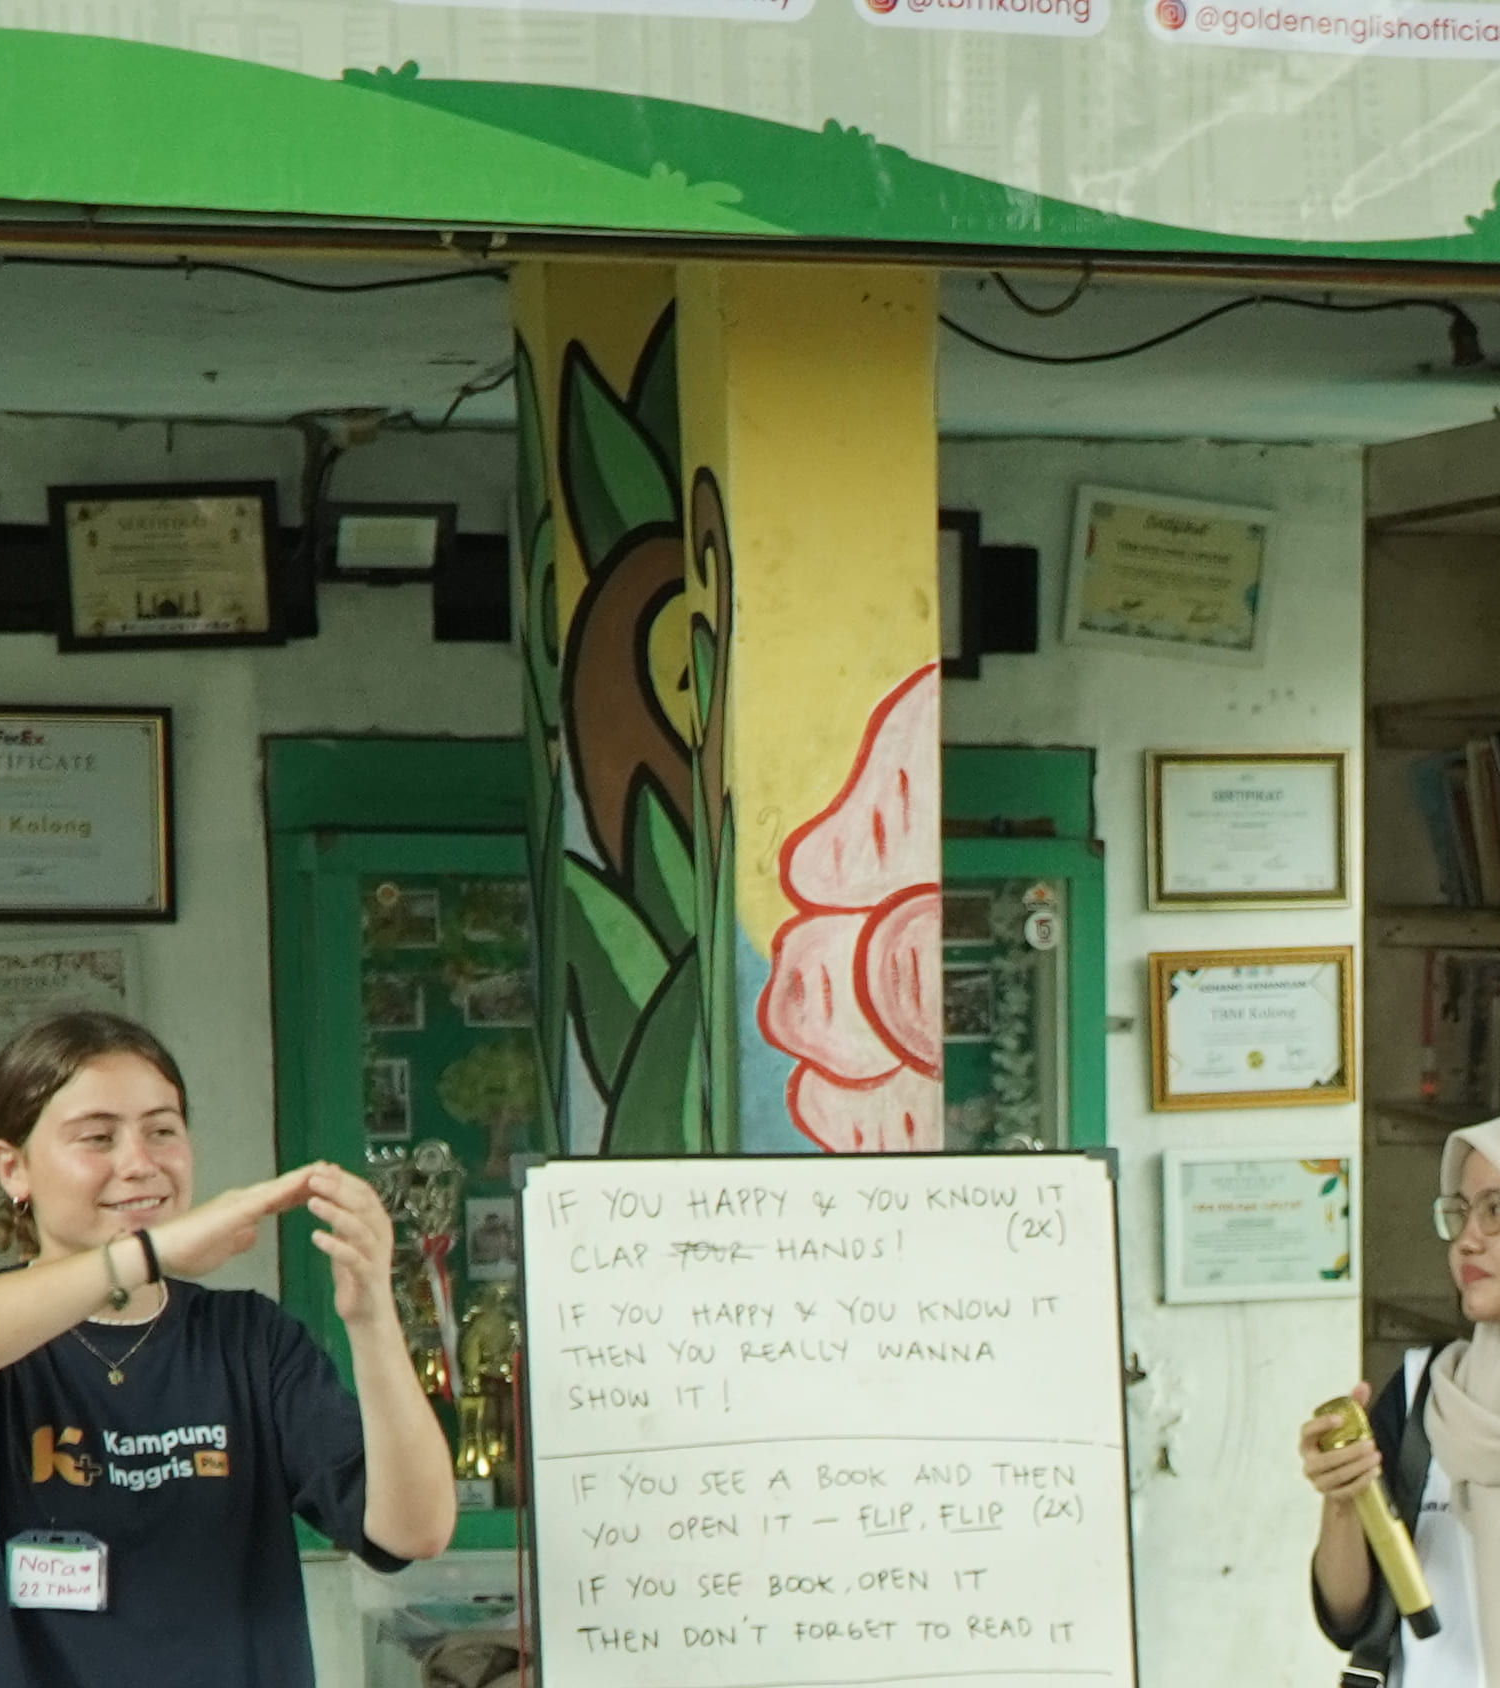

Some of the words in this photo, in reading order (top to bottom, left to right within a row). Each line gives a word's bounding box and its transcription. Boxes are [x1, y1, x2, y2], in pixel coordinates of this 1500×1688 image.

[10, 814, 92, 837] Kolong
[548, 1190, 580, 1228] IF
[600, 1188, 662, 1220] YOU
[686, 1187, 789, 1219] HAPPY
[857, 1187, 909, 1213] YOU
[926, 1185, 1019, 1210] KNOW
[1037, 1184, 1066, 1203] IT
[570, 1242, 648, 1274] CLAP
[775, 1229, 906, 1263] HANDS!
[558, 1301, 586, 1333] IF
[610, 1301, 664, 1328] YOU
[691, 1300, 775, 1329] HAPPY
[839, 1297, 898, 1325] YOU
[917, 1294, 1013, 1323] KNOW
[1031, 1294, 1060, 1317] IT
[560, 1344, 648, 1368] THEN
[667, 1341, 717, 1365] YOU
[739, 1337, 850, 1364] REALLY
[876, 1340, 997, 1363] WANNA
[567, 1384, 651, 1411] SHOW
[103, 1424, 228, 1456] Kampung
[108, 1456, 194, 1491] Inggris
[572, 1471, 597, 1507] IF
[619, 1465, 678, 1501] YOU
[699, 1469, 746, 1496] SEE
[767, 1466, 793, 1492] A
[816, 1464, 888, 1490] BOOK
[914, 1463, 973, 1488] AND
[991, 1462, 1077, 1490] THEN
[581, 1521, 641, 1549] YOU
[667, 1516, 739, 1541] OPEN
[762, 1513, 793, 1536] IT
[939, 1501, 1003, 1529] FLIP
[18, 1555, 77, 1577] Nora
[577, 1575, 608, 1607] IF
[626, 1573, 676, 1600] YOU
[697, 1572, 743, 1597] SEE
[857, 1568, 930, 1593] OPEN
[953, 1567, 988, 1591] IT
[683, 1614, 766, 1648] DON'T
[793, 1619, 900, 1645] FORGET
[916, 1619, 951, 1642] TO
[966, 1614, 1032, 1639] READ
[1048, 1620, 1076, 1644] IT
